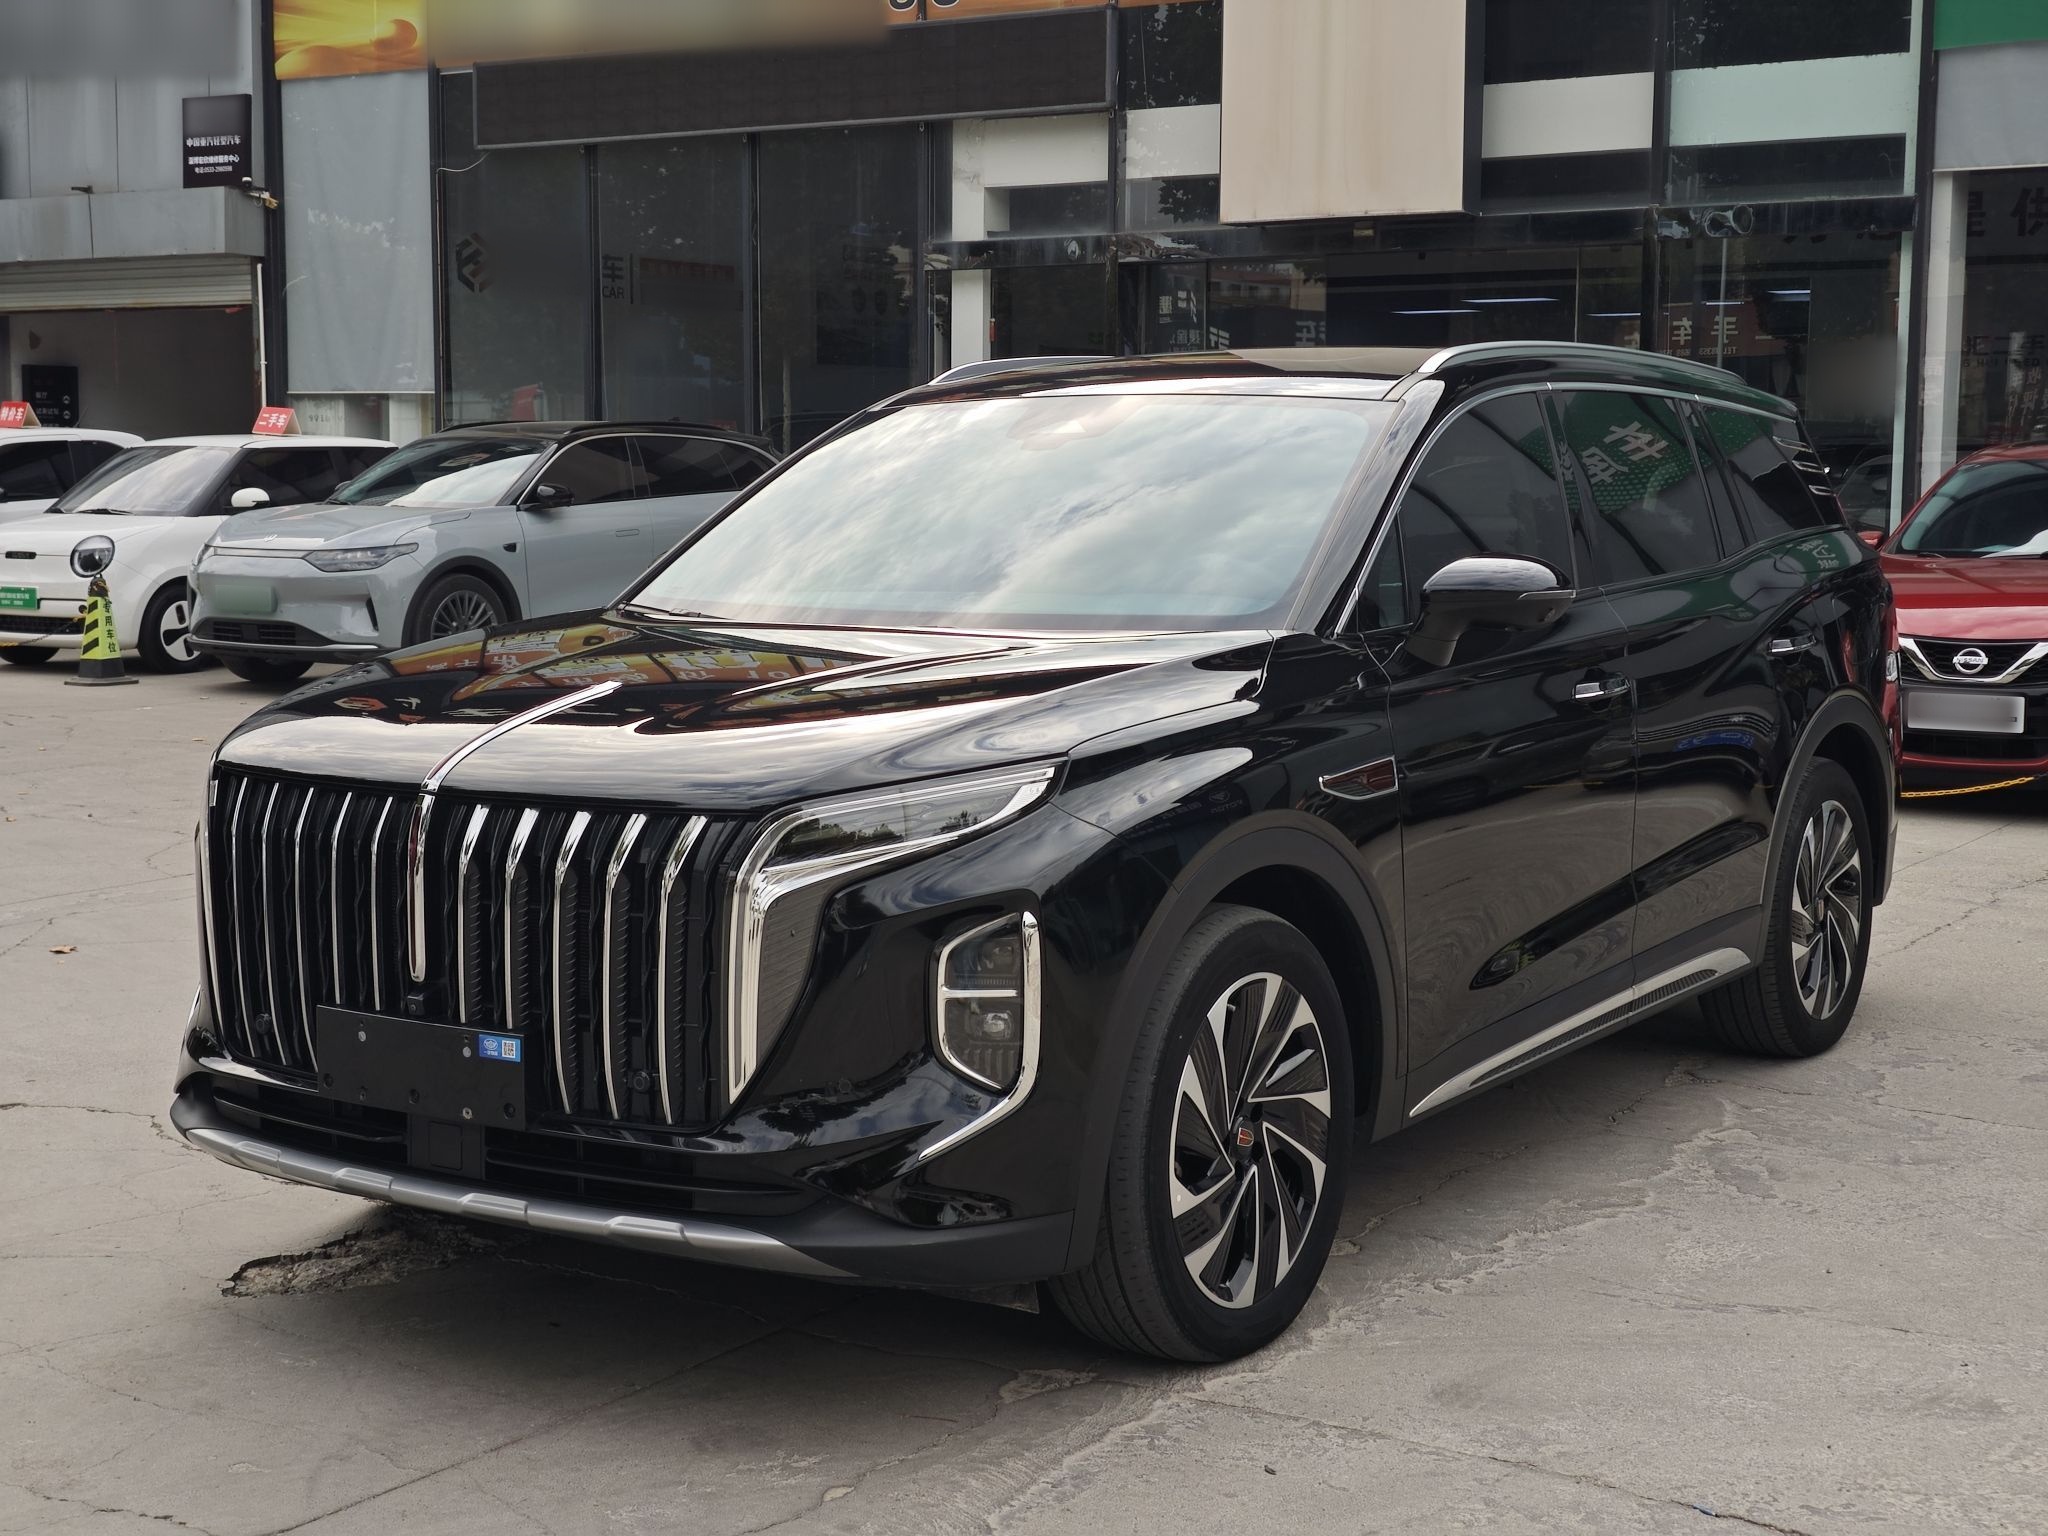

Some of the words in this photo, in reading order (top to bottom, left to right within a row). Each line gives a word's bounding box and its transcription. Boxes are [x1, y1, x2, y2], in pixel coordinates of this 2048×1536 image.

[602, 287, 625, 300] CAR
[258, 412, 288, 429] 二手车
